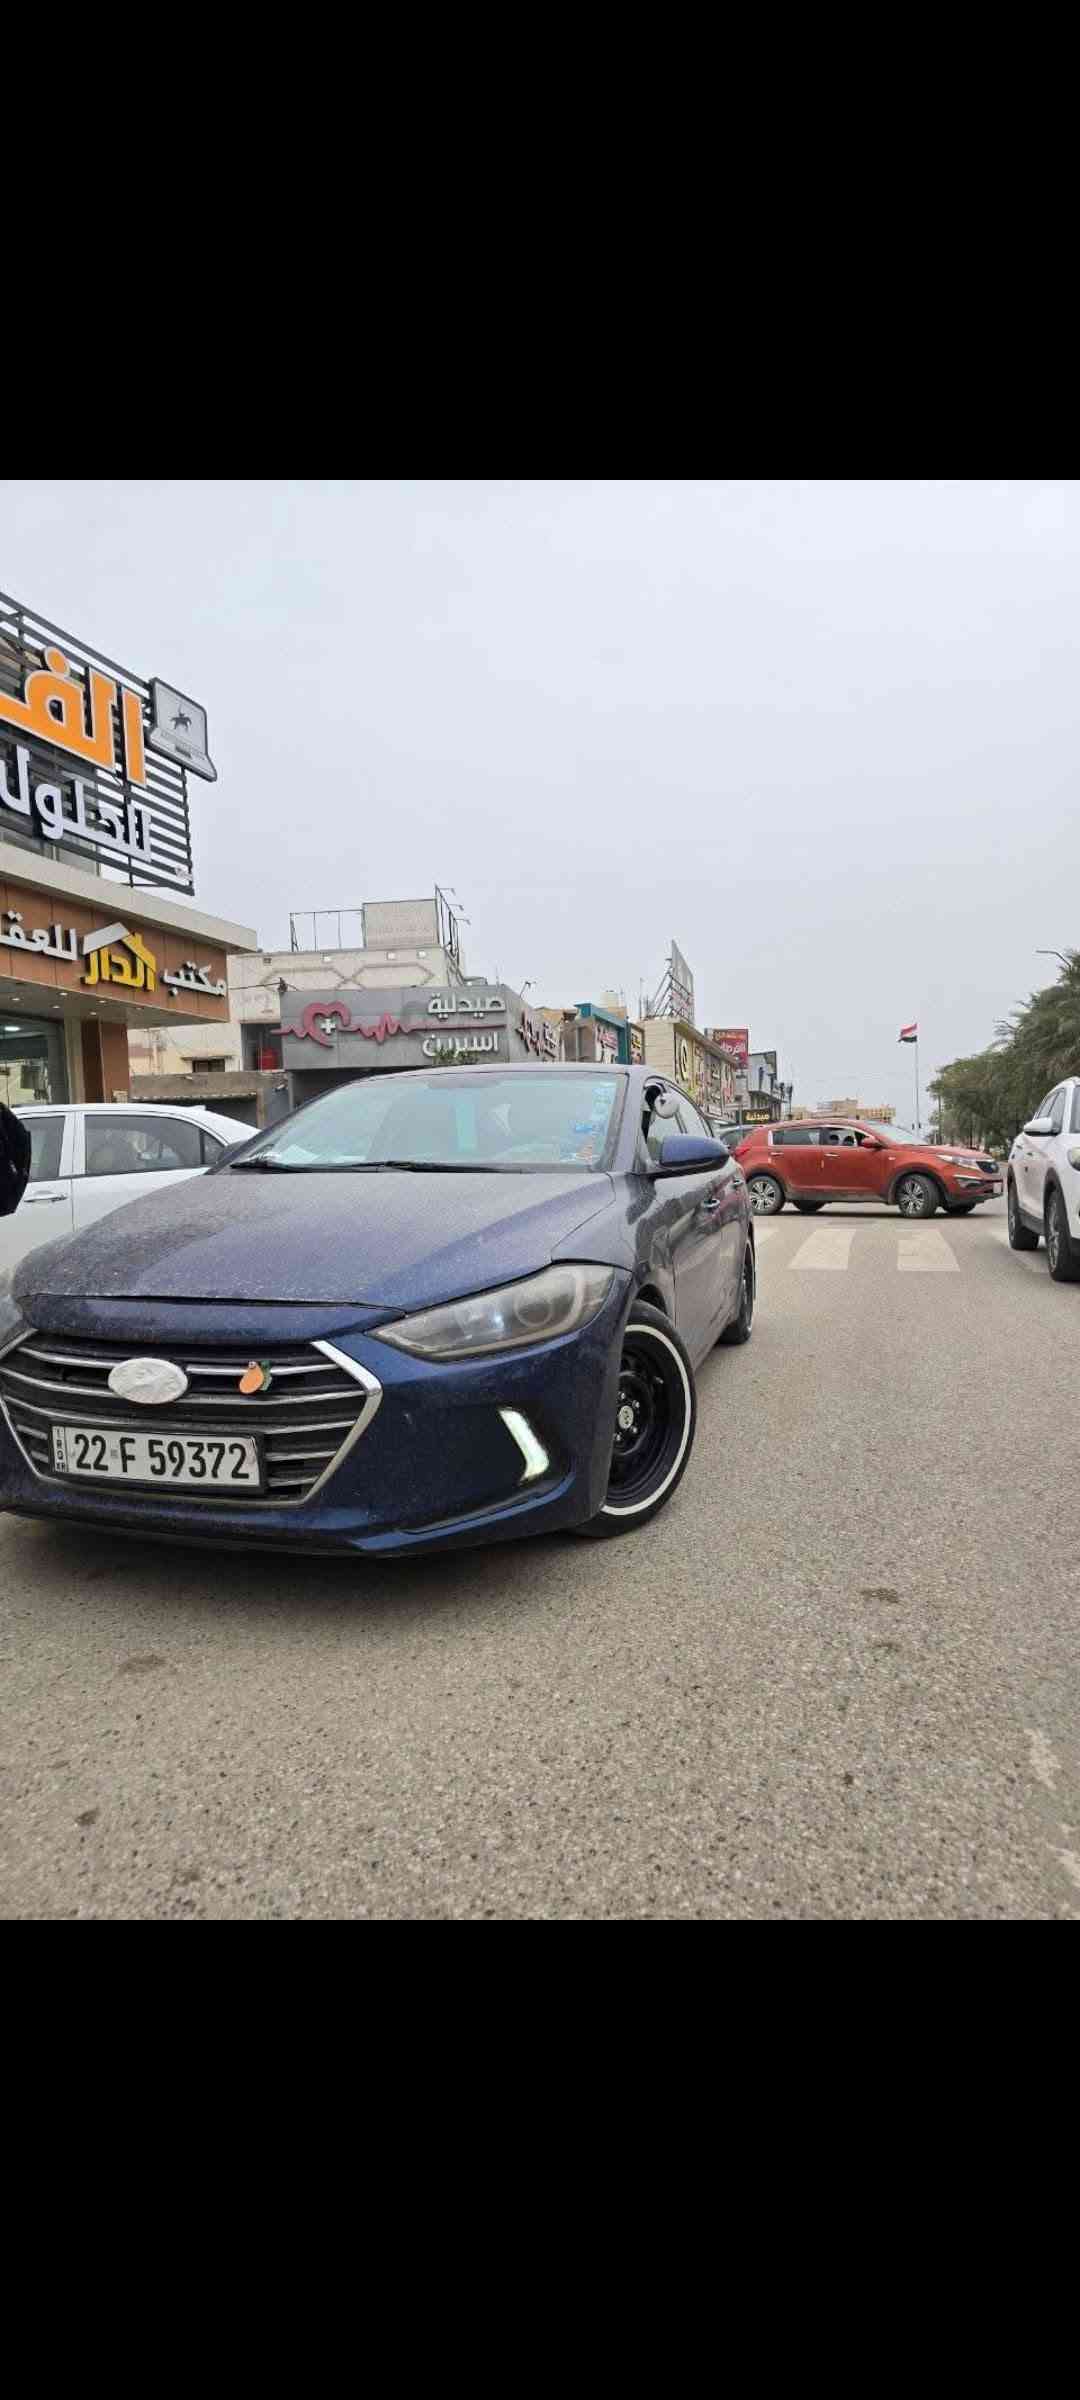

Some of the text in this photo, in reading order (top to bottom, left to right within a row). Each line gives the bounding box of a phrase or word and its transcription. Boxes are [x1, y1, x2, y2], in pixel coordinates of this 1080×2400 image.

[0, 646, 147, 788] الف
[0, 910, 227, 997] مكتب الدار للعق
[428, 993, 507, 1019] صيدلية
[74, 1433, 250, 1480] 22 F 59372
